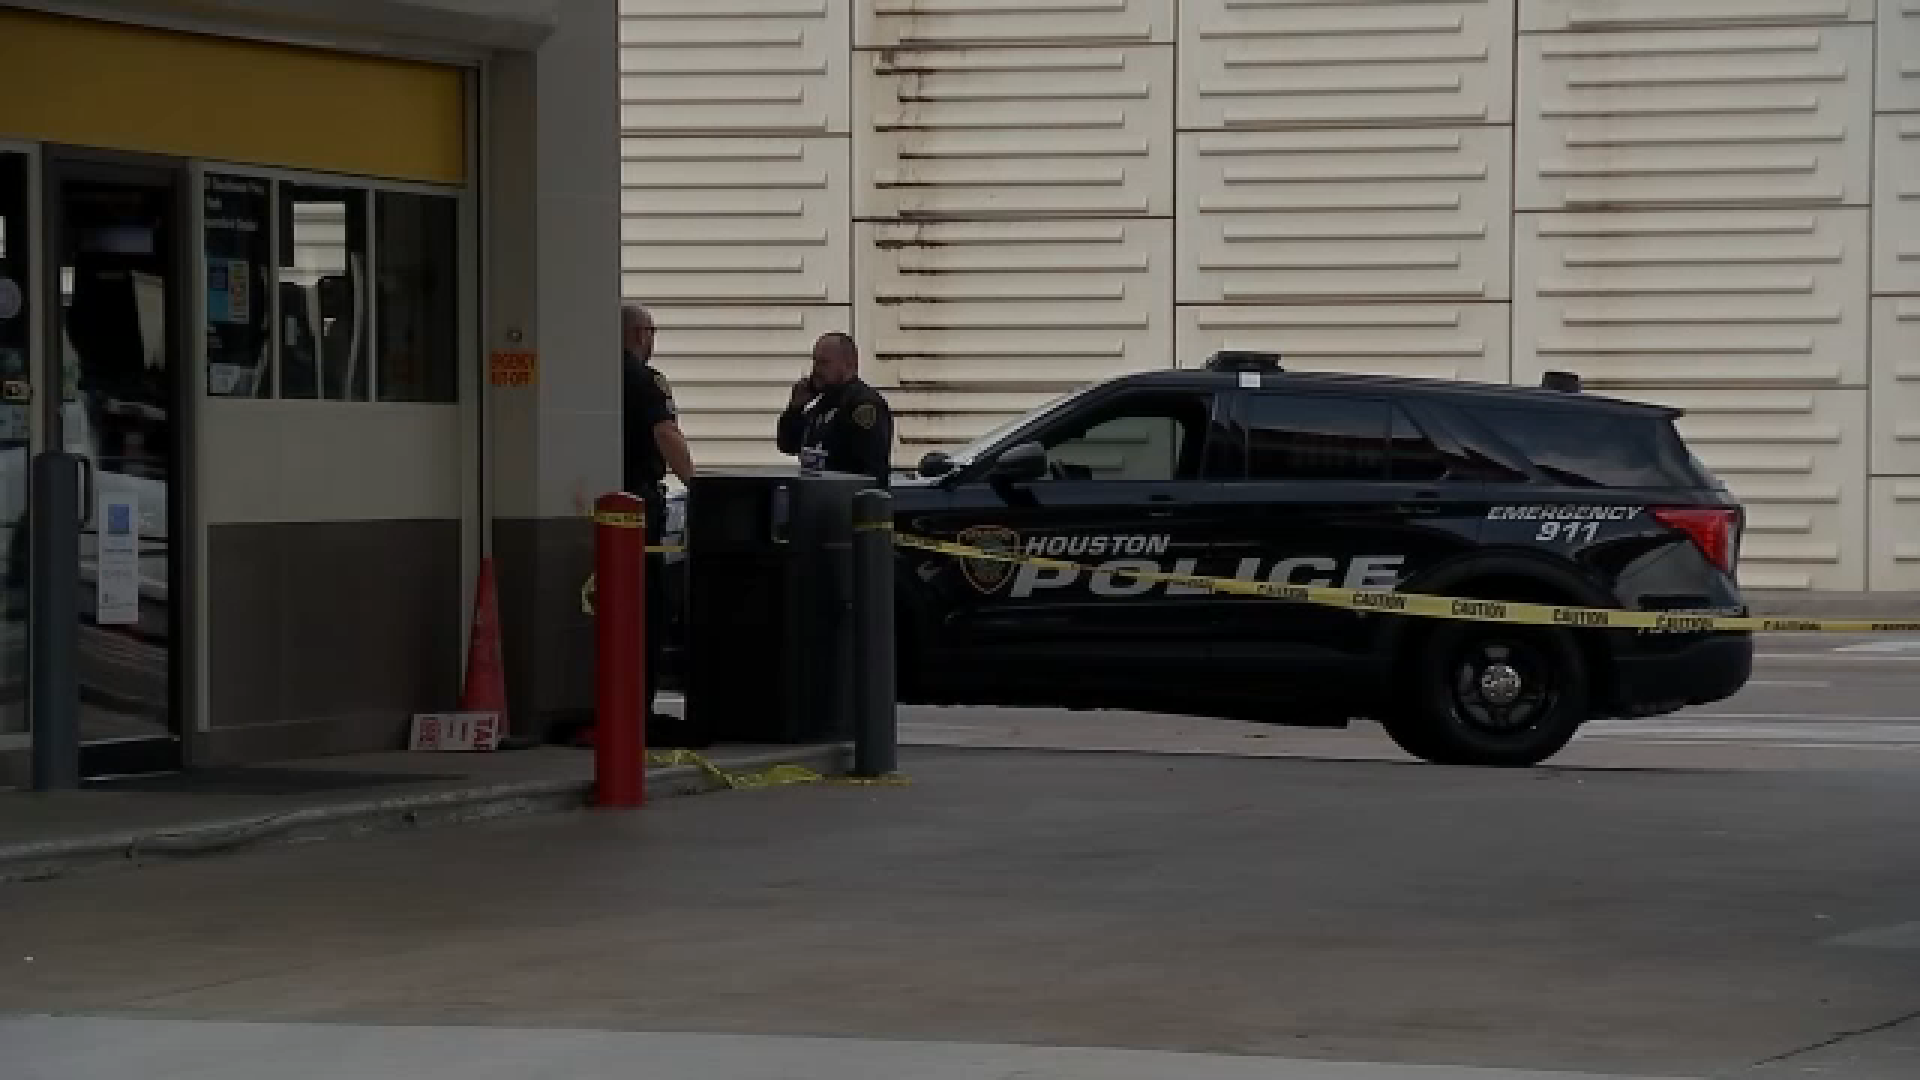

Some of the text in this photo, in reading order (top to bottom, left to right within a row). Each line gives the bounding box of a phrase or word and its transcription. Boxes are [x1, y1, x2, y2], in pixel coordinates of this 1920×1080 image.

[1487, 505, 1644, 520] EMERGENCY
[1536, 521, 1600, 543] 911
[1025, 534, 1171, 555] HOUSTON
[1010, 555, 1405, 597] POLICE
[1351, 591, 1405, 610] CAUTION
[1451, 602, 1507, 620] CAUTION
[1553, 607, 1609, 625] CAUTION
